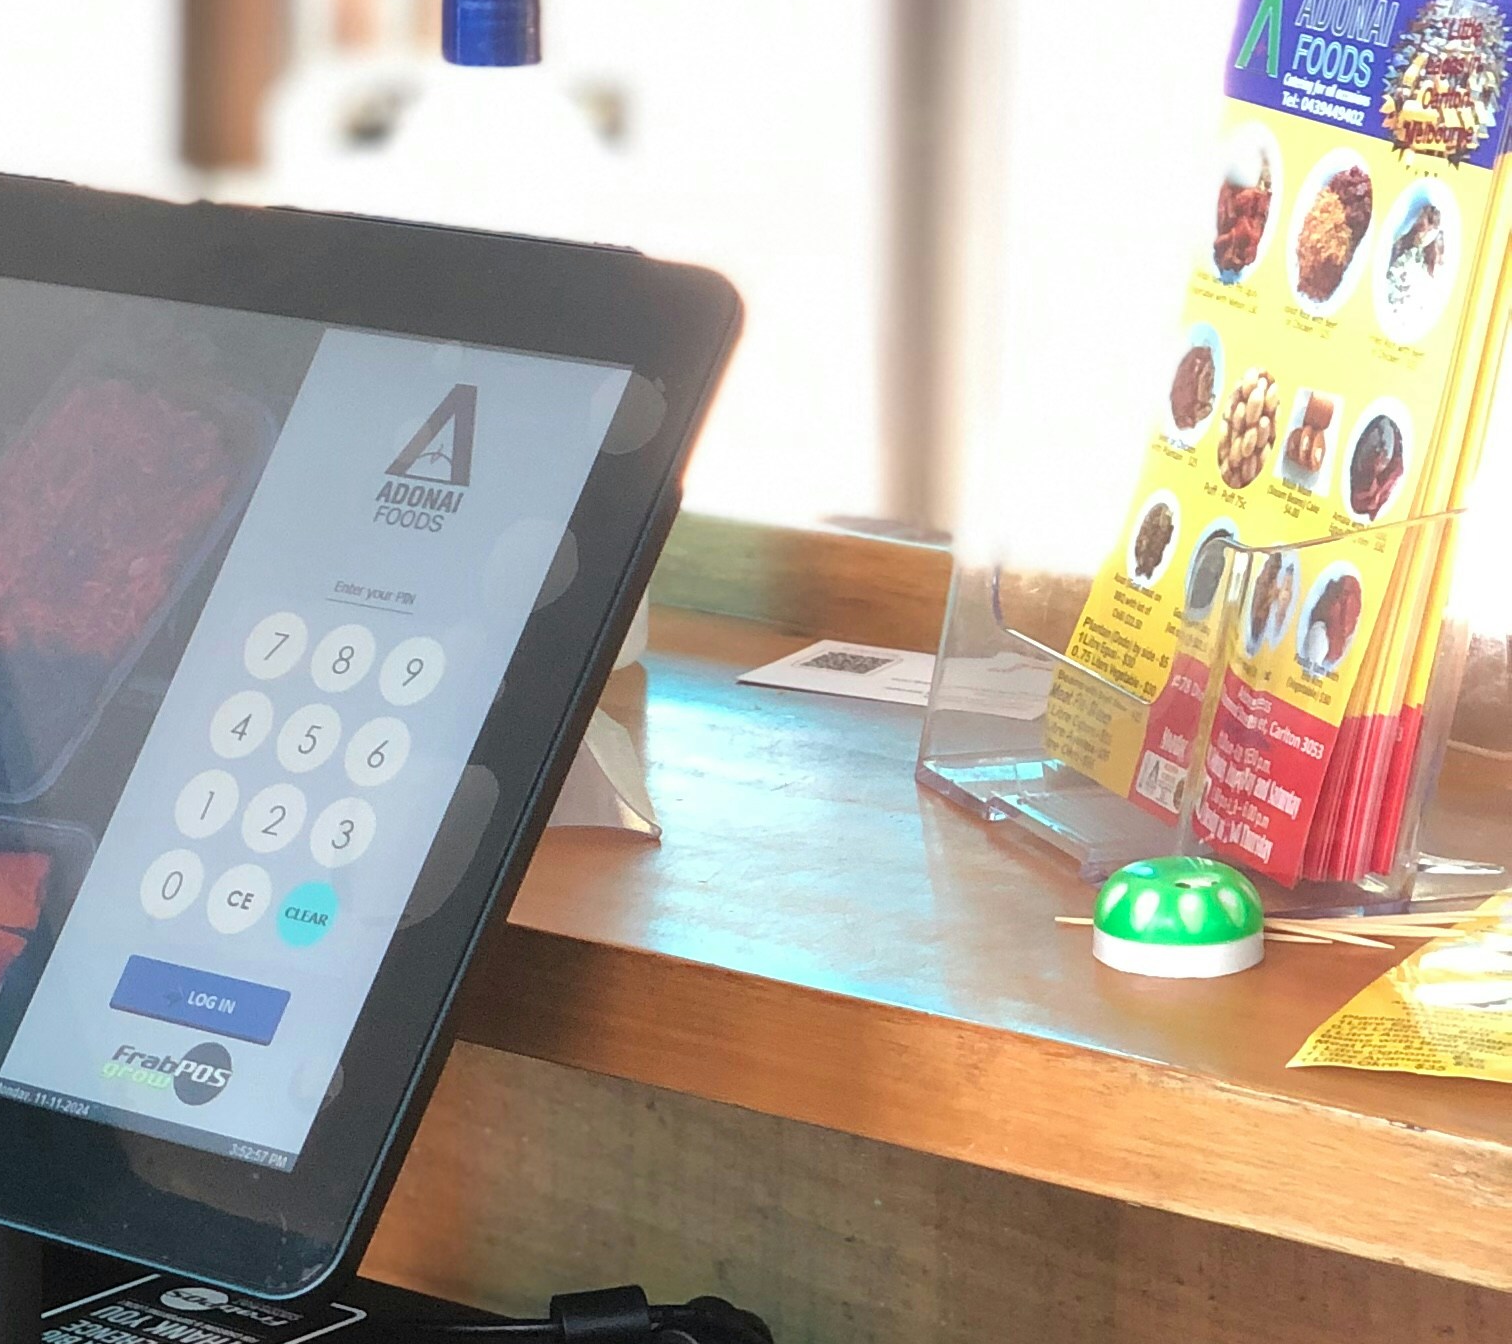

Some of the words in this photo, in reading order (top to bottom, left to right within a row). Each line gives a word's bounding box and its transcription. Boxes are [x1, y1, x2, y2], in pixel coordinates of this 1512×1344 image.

[1292, 34, 1374, 87] FOODS
[375, 480, 464, 513] ADONAI
[373, 505, 445, 533] FOODS
[334, 579, 364, 597] Enter
[365, 586, 393, 602] your
[395, 591, 416, 606] PIN
[264, 632, 289, 660] 7
[332, 645, 354, 674] 8
[402, 658, 424, 687] 9
[231, 713, 252, 742] 4
[298, 725, 322, 754] 5
[367, 739, 389, 768] 6
[1269, 720, 1302, 750] Carlton
[1301, 736, 1325, 760] 3053
[200, 790, 215, 820] 1
[261, 805, 286, 836] 2
[331, 819, 354, 849] 3
[161, 871, 183, 900] 0
[227, 890, 254, 910] CE
[284, 906, 329, 927] CLEAR
[188, 990, 216, 1010] LOG
[217, 997, 236, 1014] IN
[100, 1062, 172, 1090] grow
[111, 1043, 232, 1088] FrabPOS
[228, 1143, 267, 1167] 3:52:57
[268, 1154, 289, 1169] PM
[89, 1305, 147, 1329] YOU
[164, 1290, 289, 1327] FrabPOS
